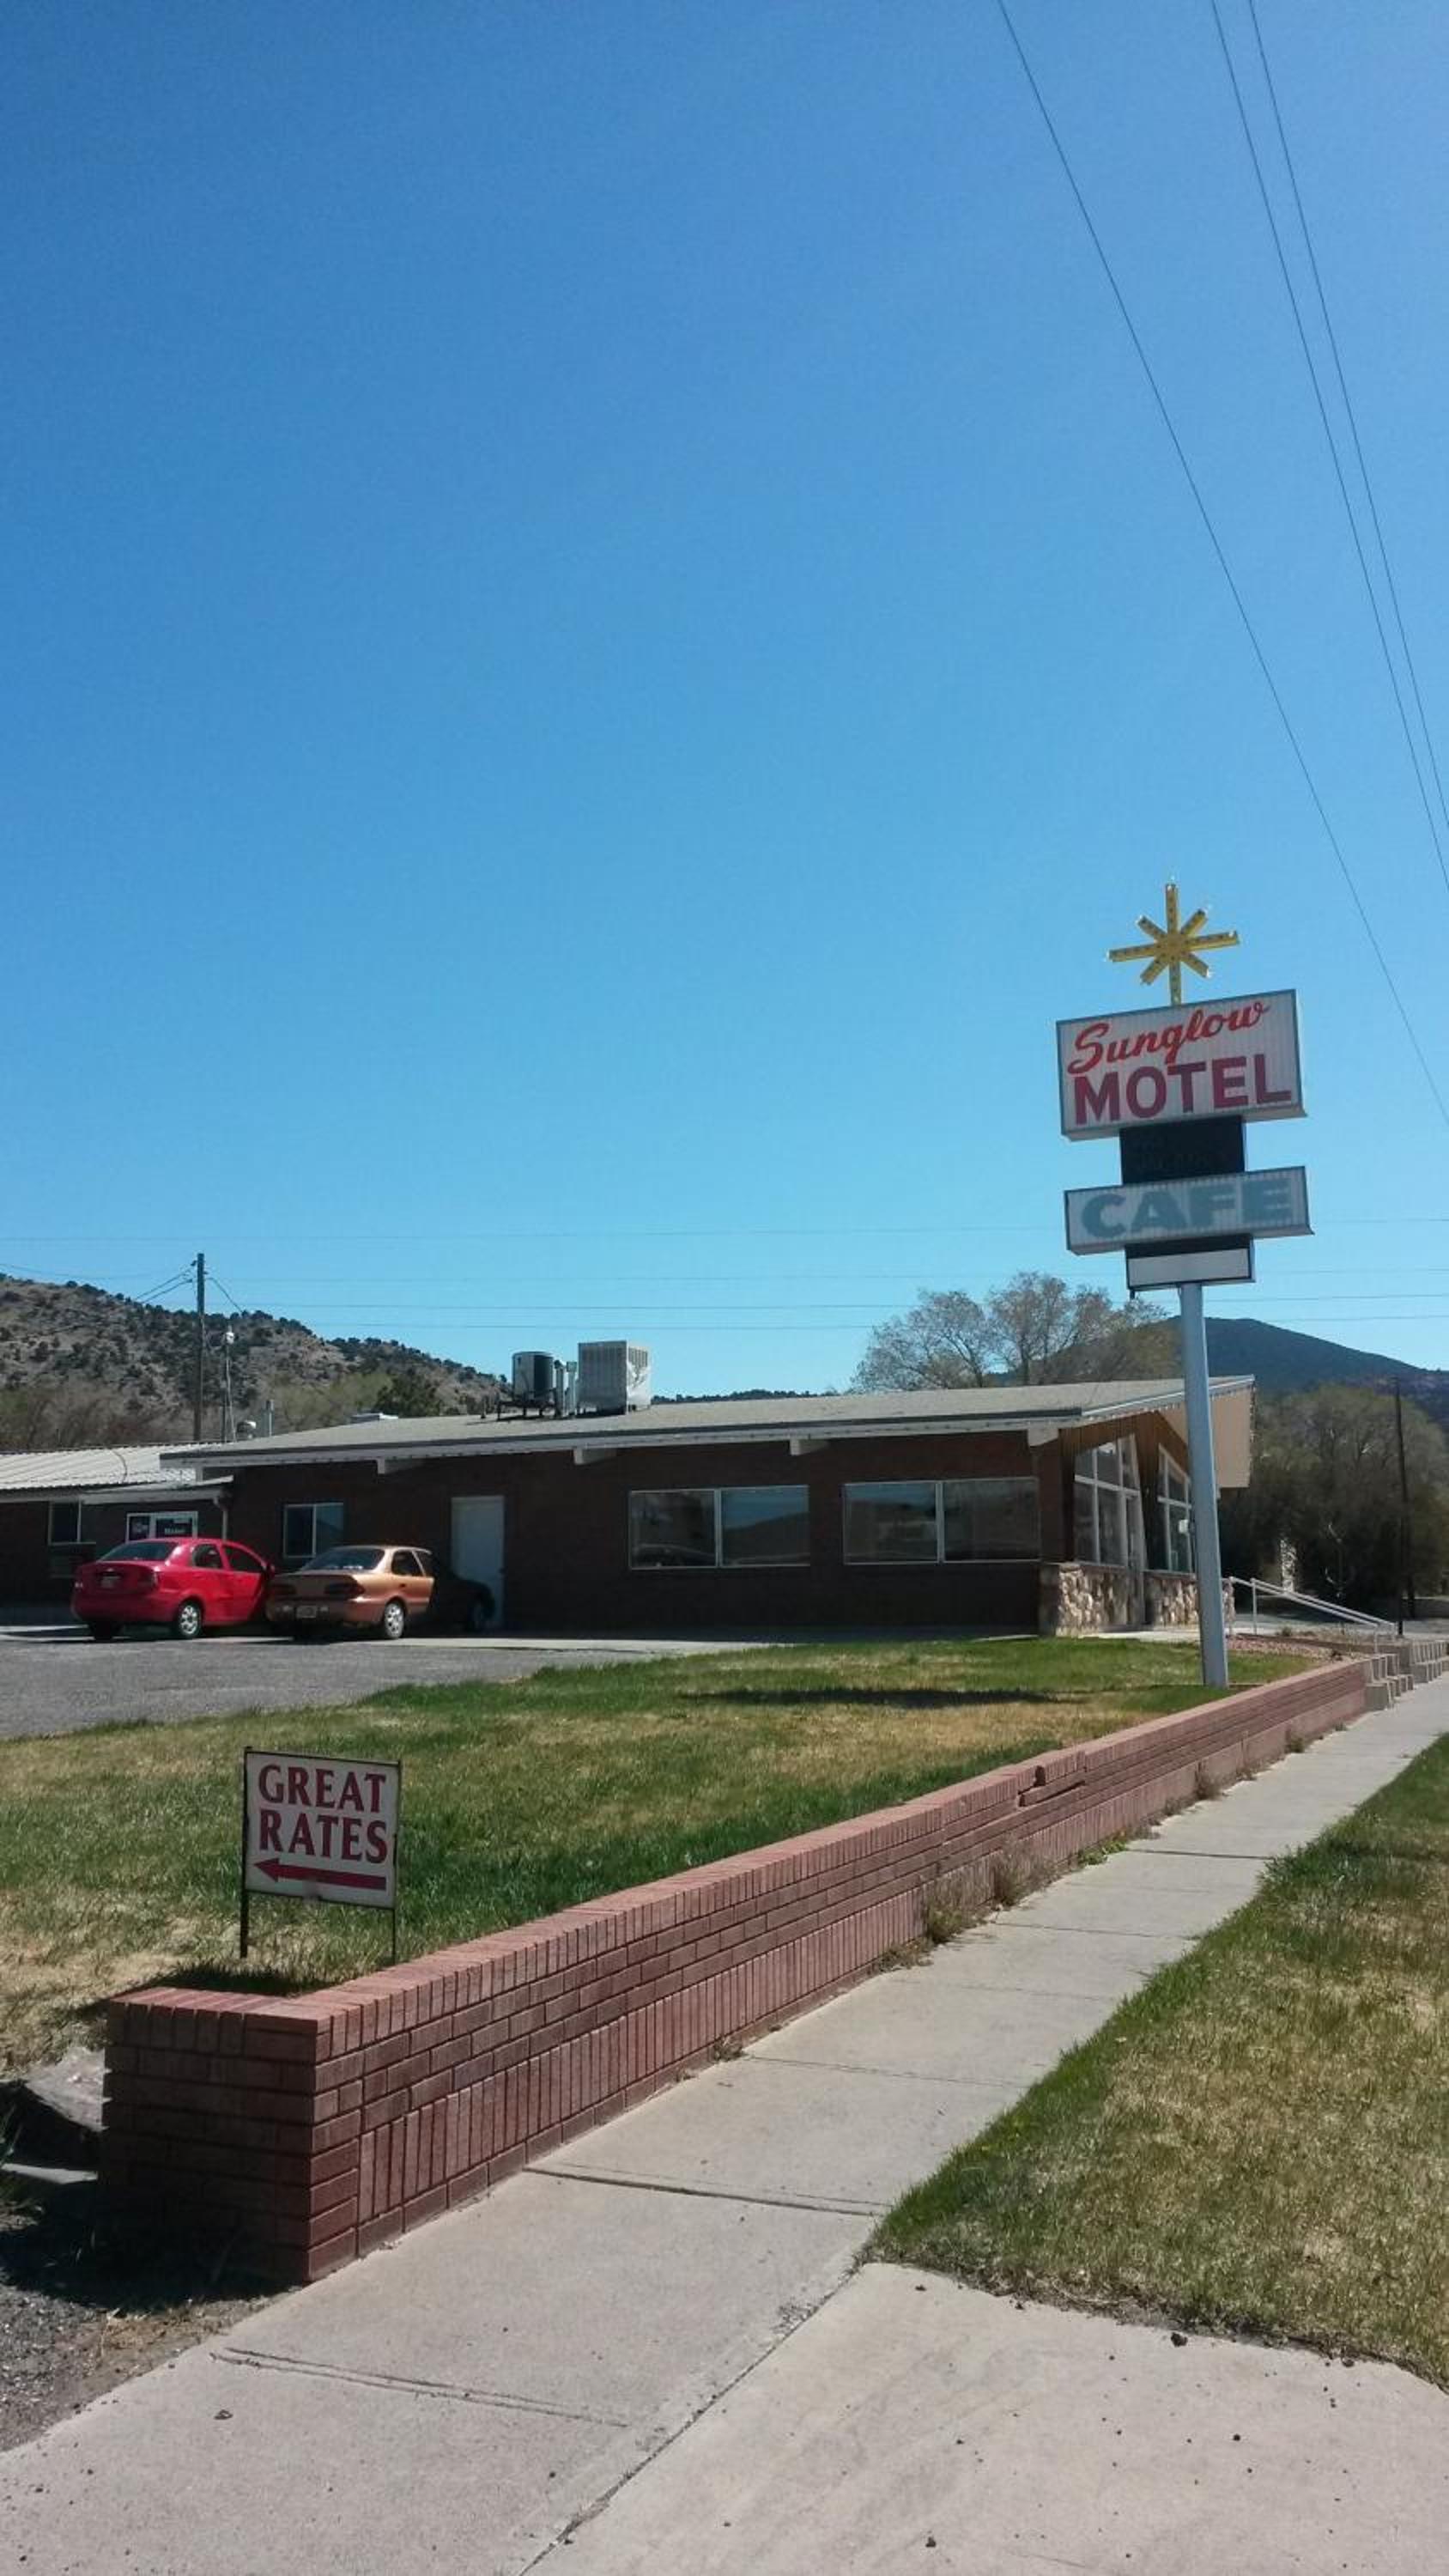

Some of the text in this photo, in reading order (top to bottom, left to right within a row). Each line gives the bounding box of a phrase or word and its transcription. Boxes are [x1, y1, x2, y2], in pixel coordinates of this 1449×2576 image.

[1068, 1000, 1270, 1074] Sunglow
[1074, 1054, 1291, 1125] MOTEL
[1081, 1178, 1292, 1238] CAFE
[259, 1764, 386, 1814] GREAT
[259, 1808, 388, 1863] RATES
